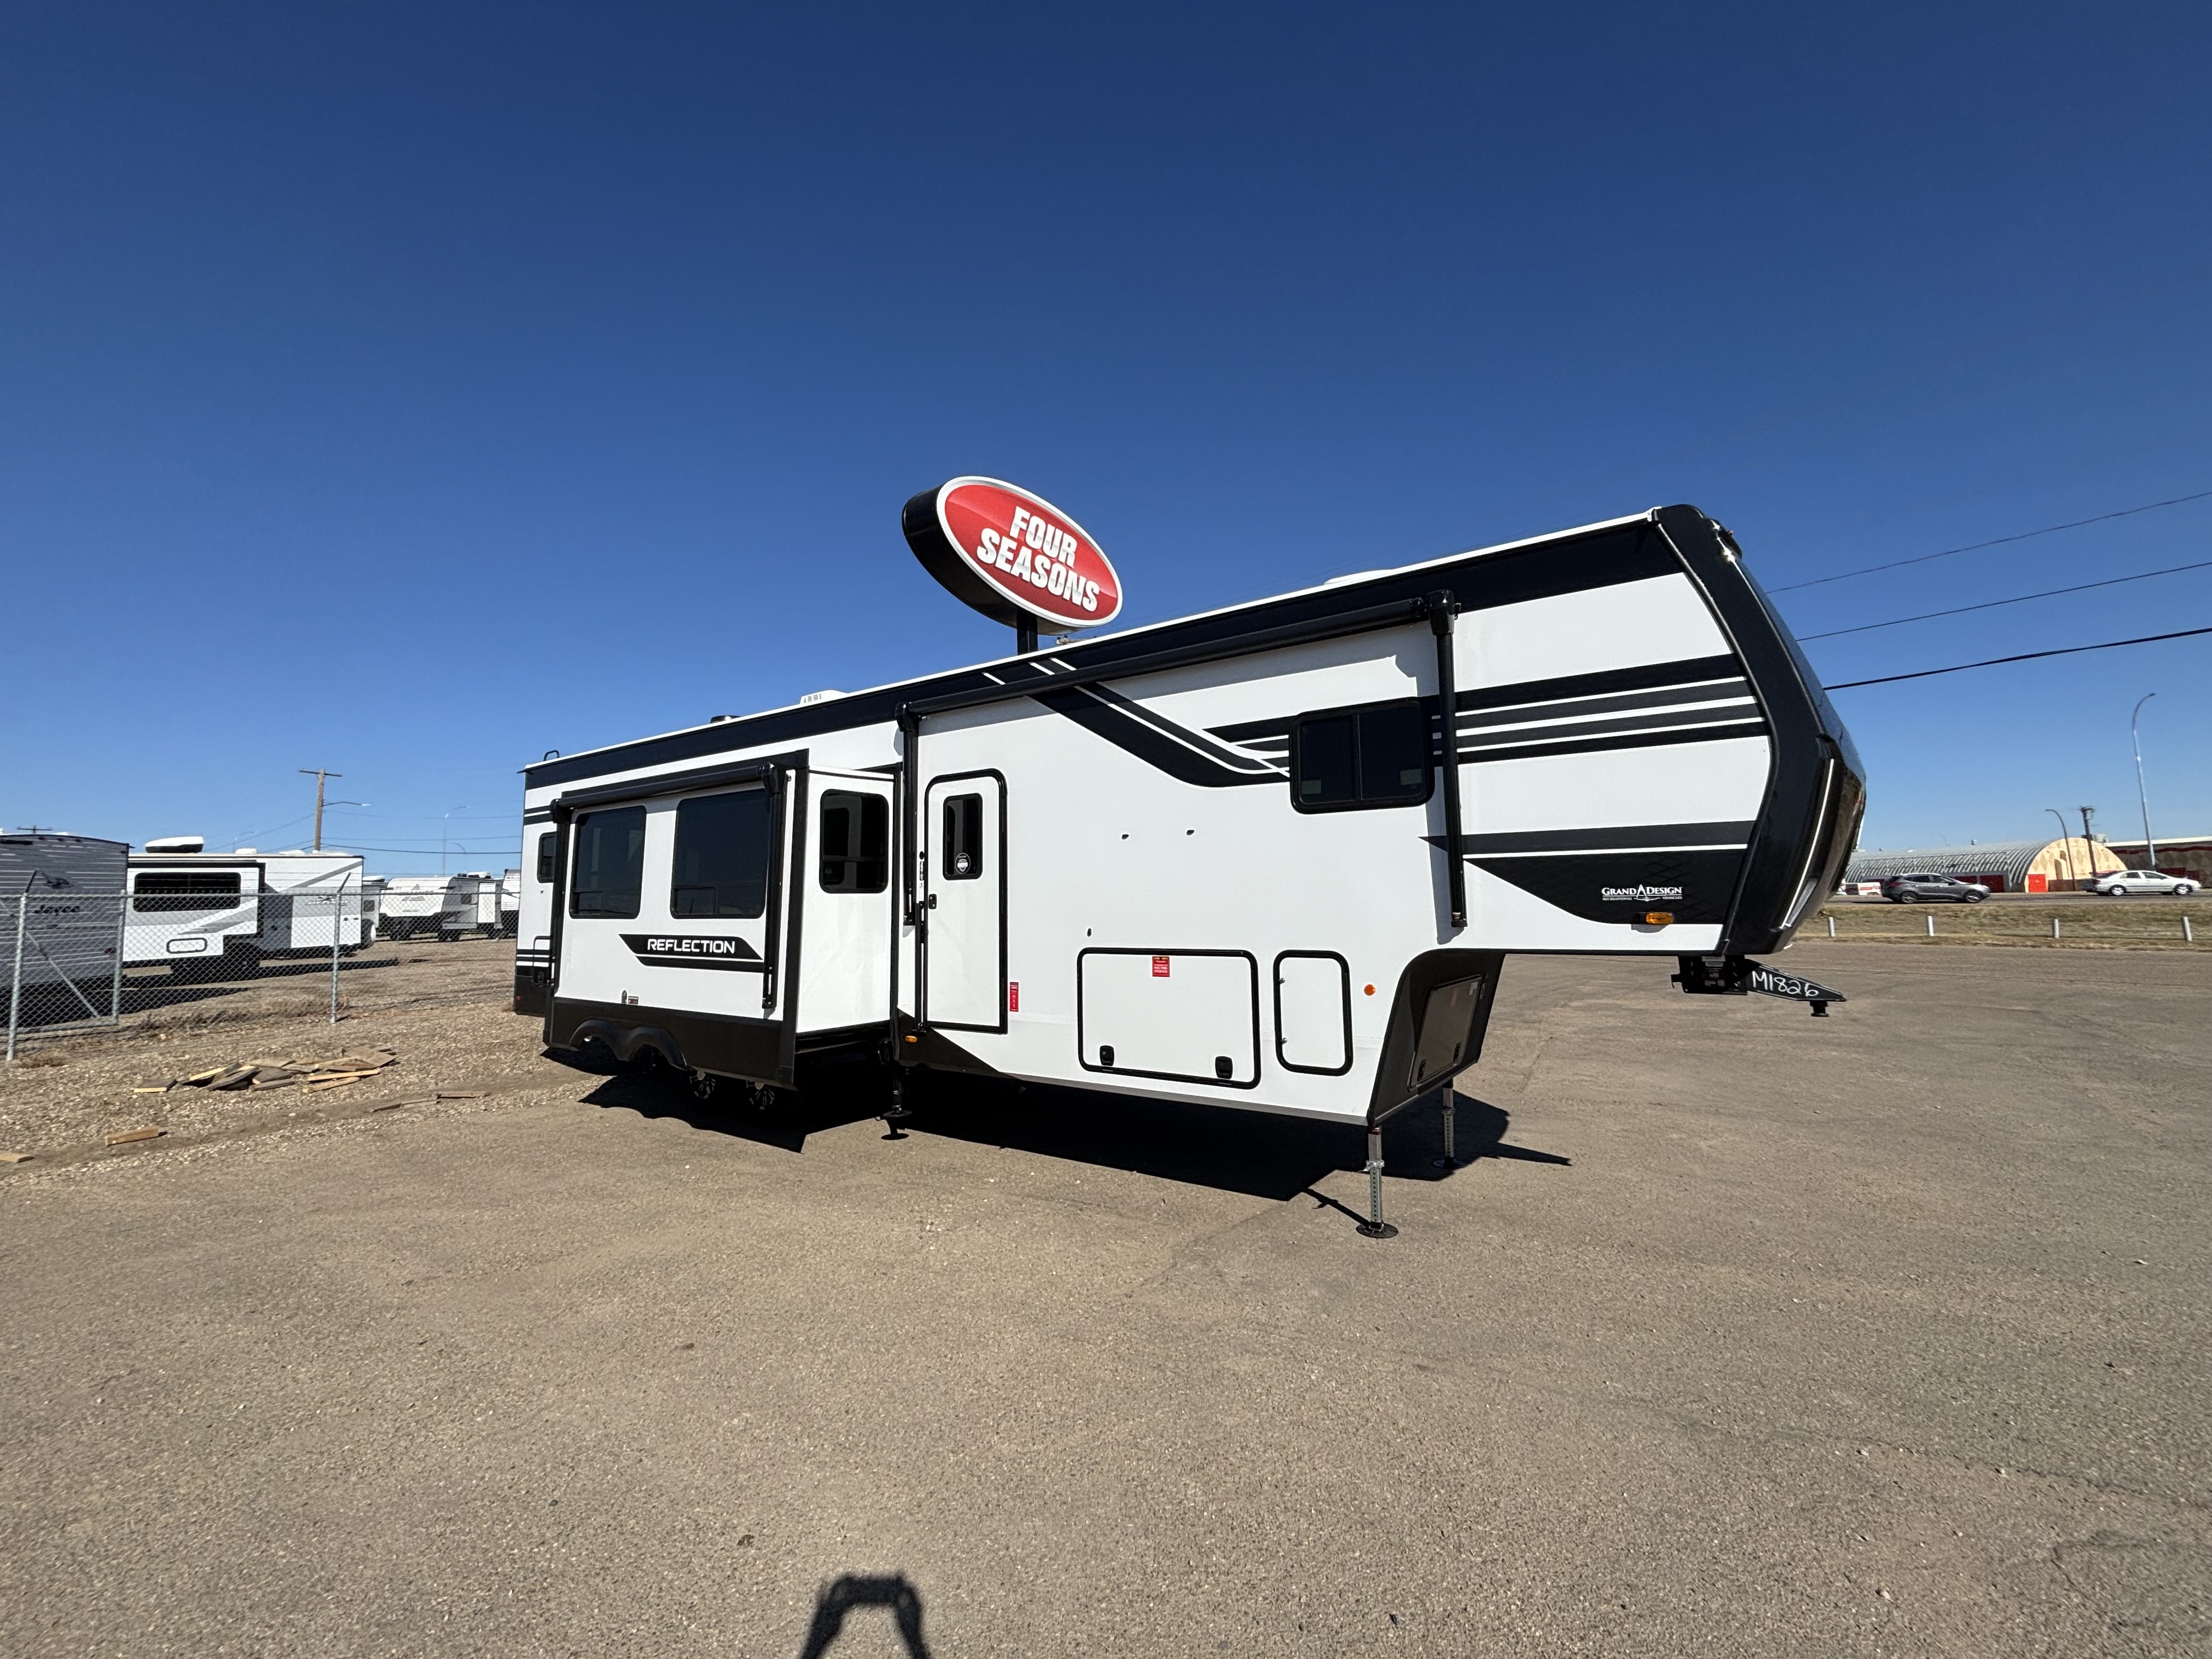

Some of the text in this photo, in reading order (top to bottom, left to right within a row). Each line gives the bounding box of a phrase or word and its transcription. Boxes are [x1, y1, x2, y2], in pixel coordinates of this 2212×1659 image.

[1009, 506, 1077, 568] FOUR
[977, 528, 1100, 612] SEASONS
[1601, 887, 1637, 895] GRAND
[647, 939, 735, 954] REFLECTION
